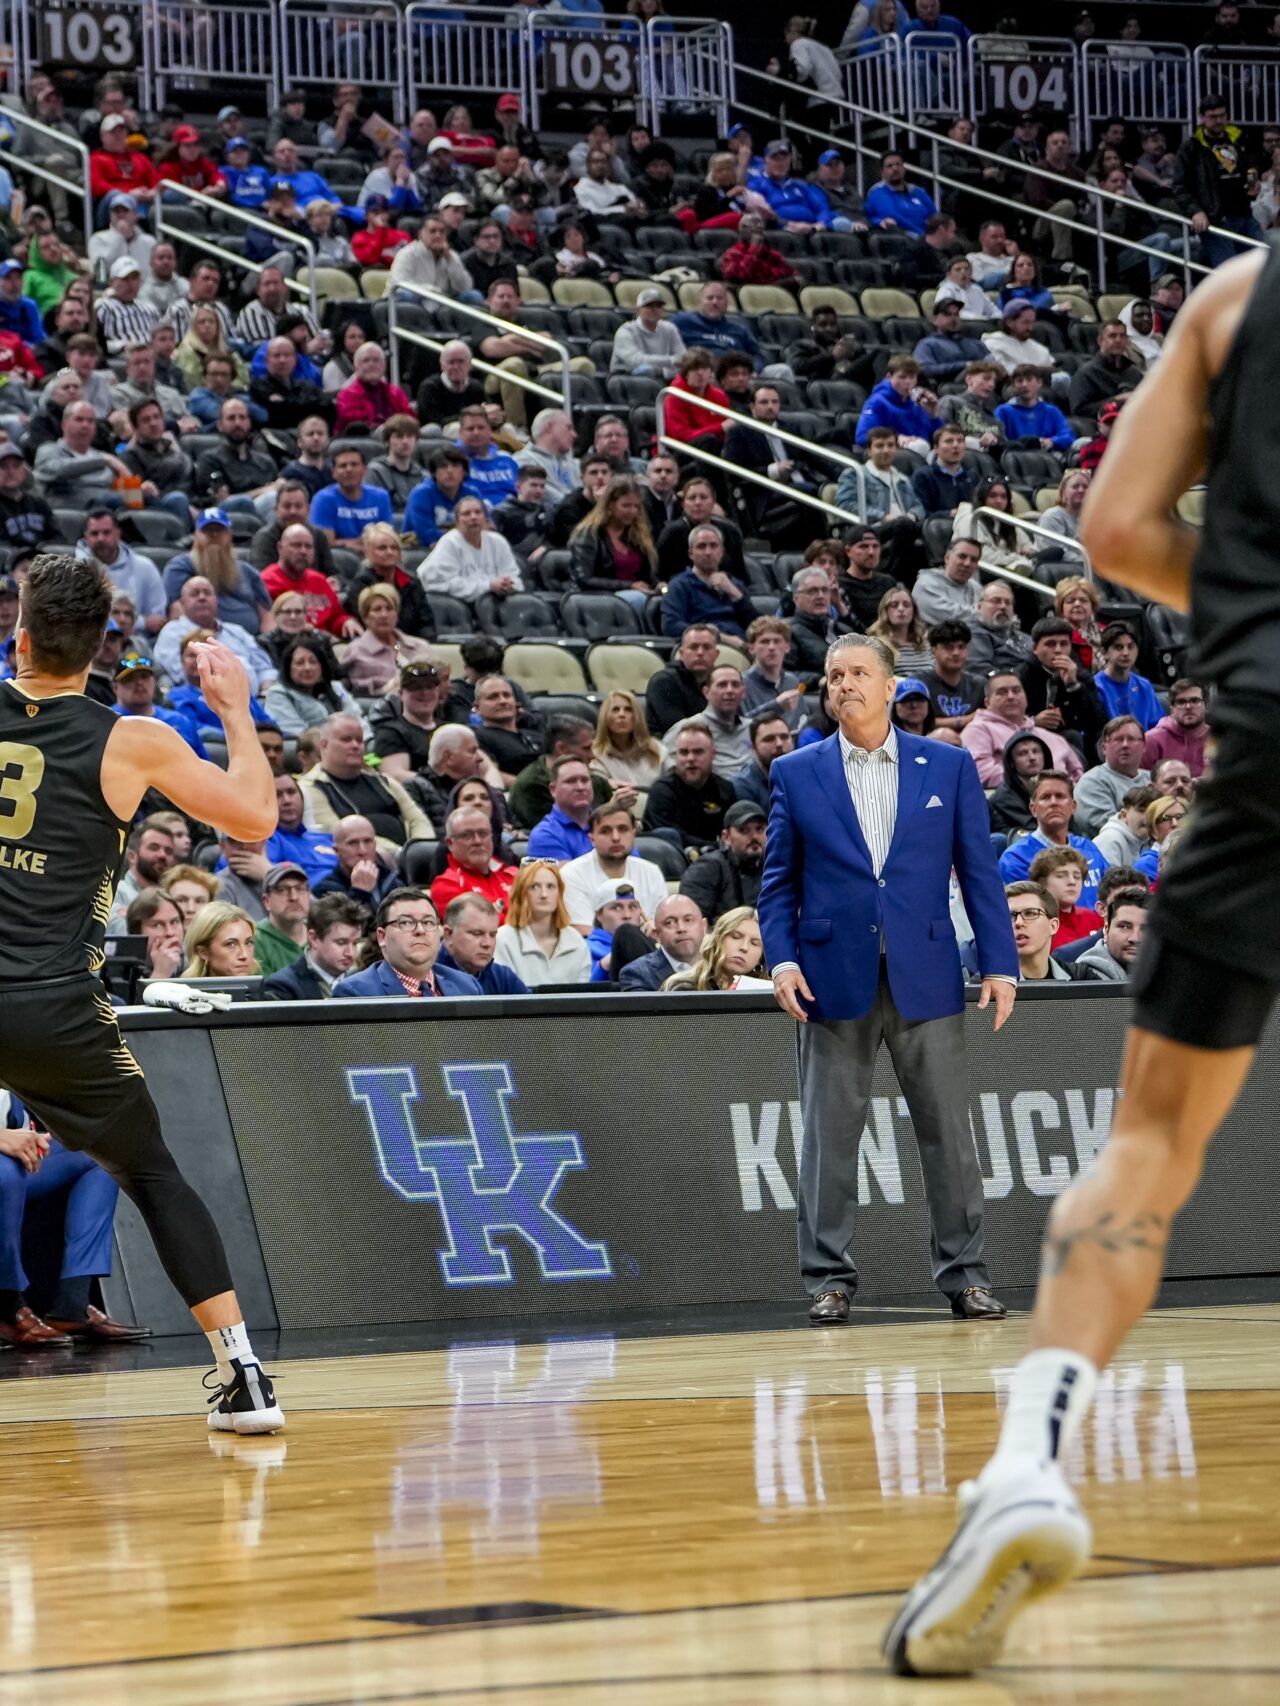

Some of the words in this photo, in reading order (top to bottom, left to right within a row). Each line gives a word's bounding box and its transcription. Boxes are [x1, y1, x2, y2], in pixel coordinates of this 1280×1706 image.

[44, 11, 134, 64] 103
[550, 42, 631, 92] 103
[989, 64, 1067, 111] 104
[342, 1060, 616, 1288] UK
